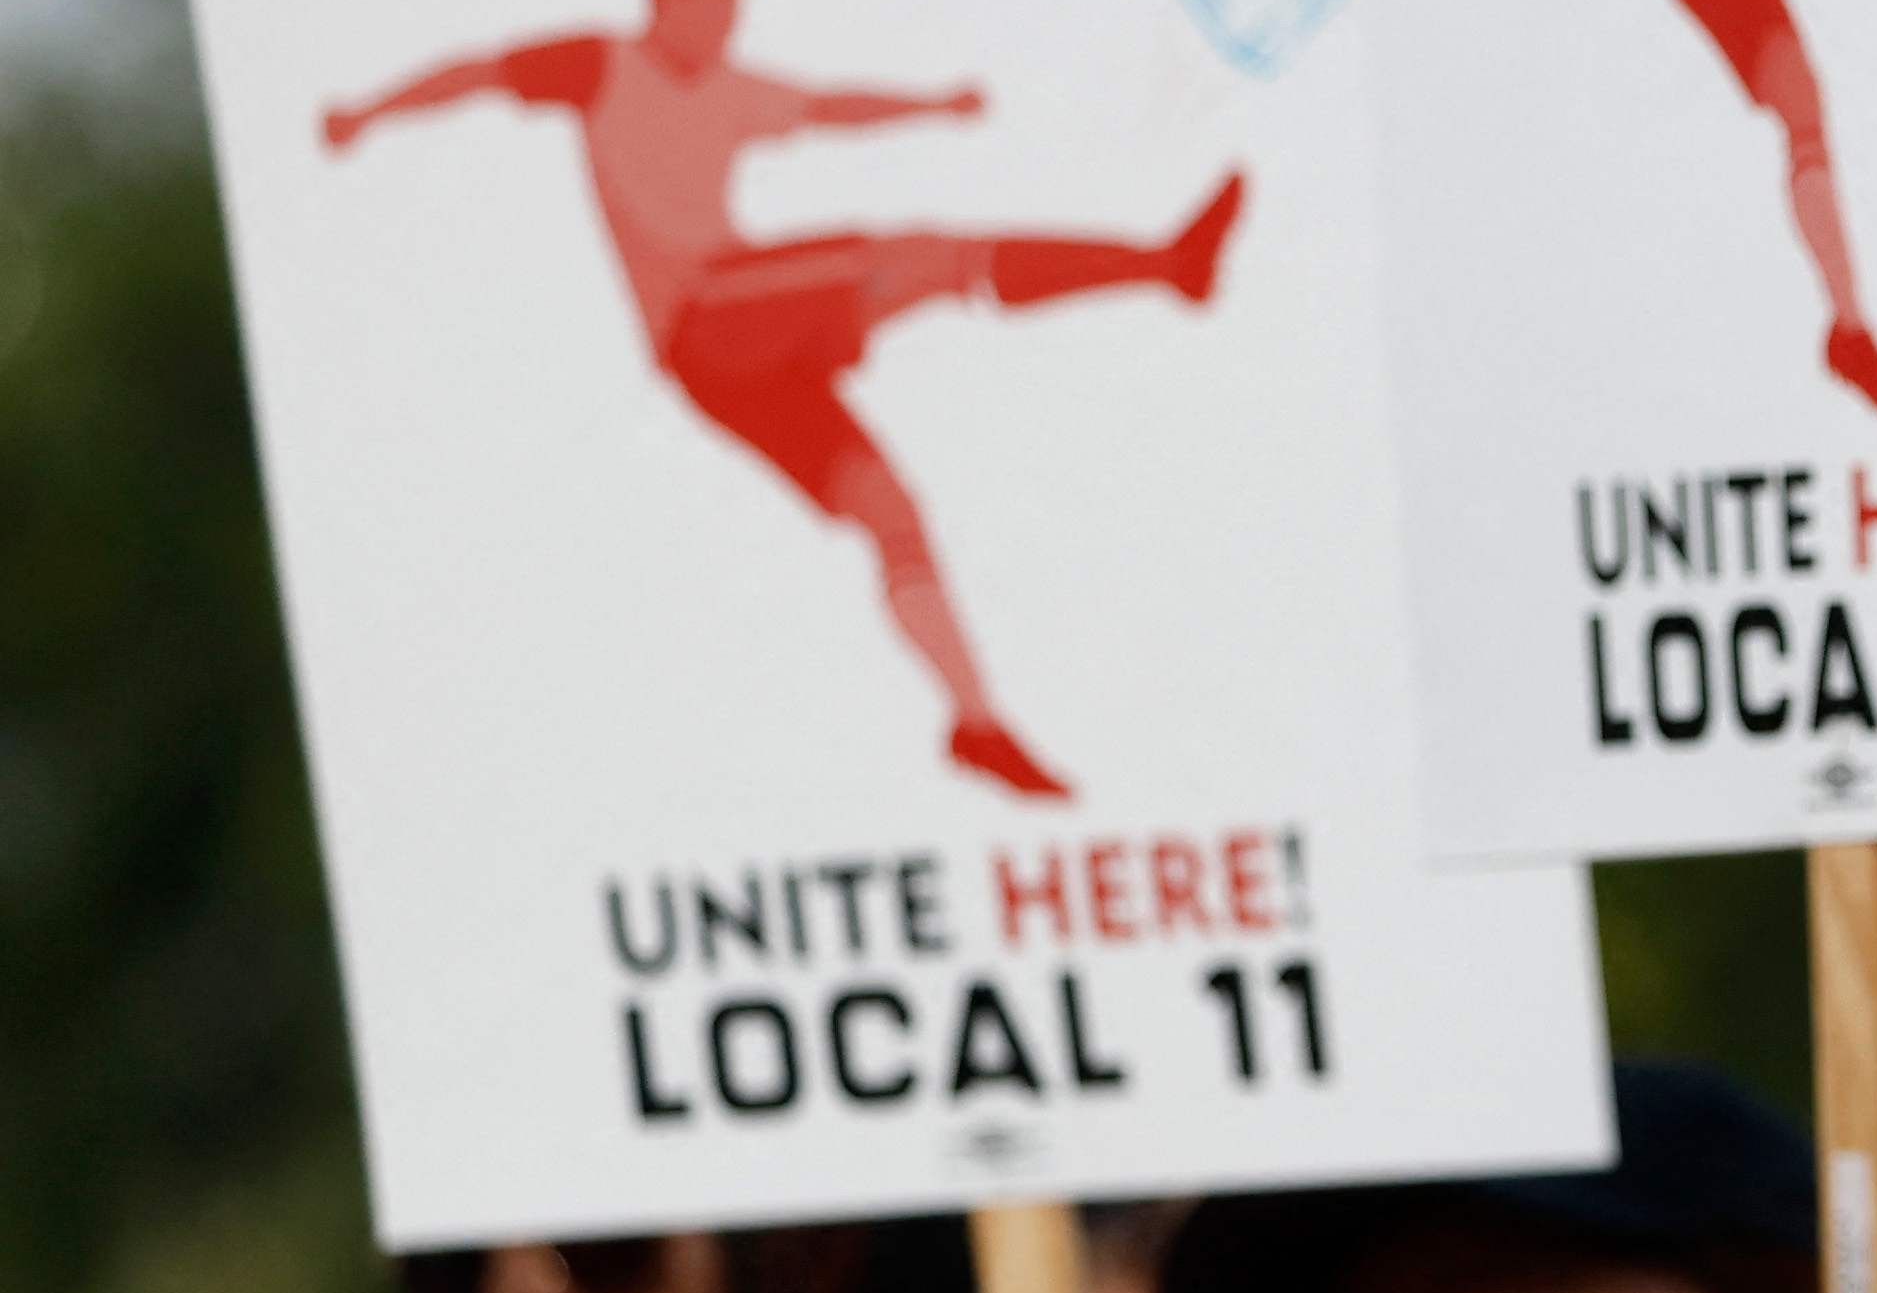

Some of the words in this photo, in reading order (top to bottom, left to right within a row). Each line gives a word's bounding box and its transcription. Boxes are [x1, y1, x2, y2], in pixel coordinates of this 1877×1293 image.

[1576, 463, 1822, 592] UNITE
[603, 854, 950, 979] UNITE
[993, 822, 1312, 948] HERE!
[619, 966, 1131, 1128] LOCAL
[1200, 953, 1334, 1088] 11
